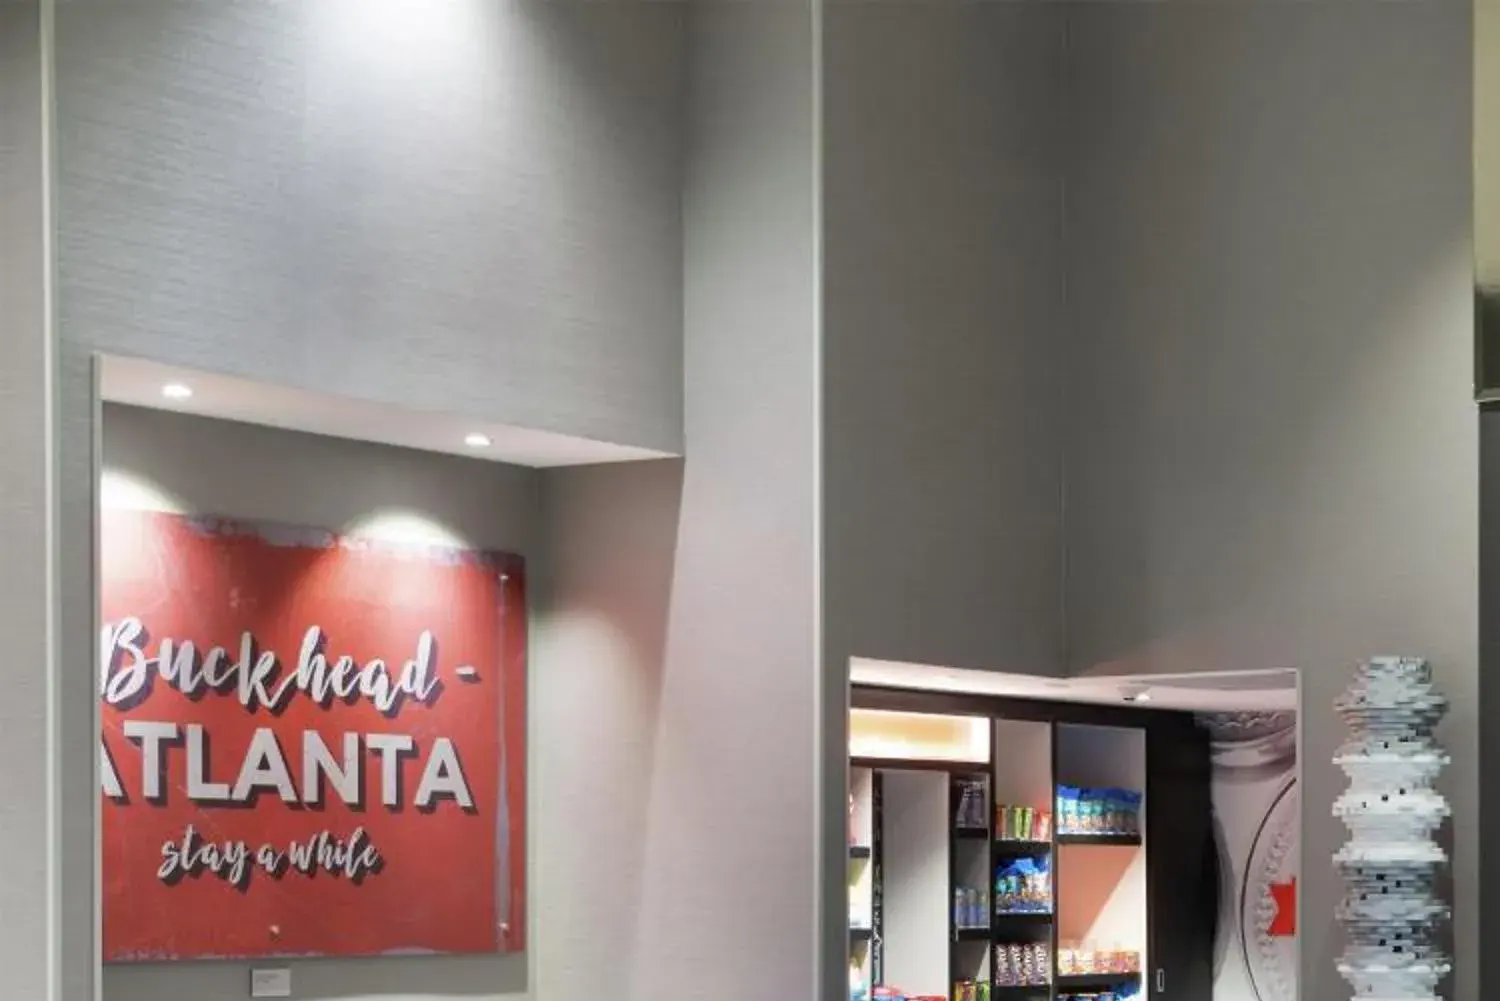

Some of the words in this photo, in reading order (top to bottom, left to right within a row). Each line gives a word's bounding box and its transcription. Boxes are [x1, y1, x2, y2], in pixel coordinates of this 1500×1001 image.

[101, 616, 440, 711] Buckhead
[157, 823, 248, 884] stay
[258, 843, 285, 872] a
[290, 826, 378, 877] while
